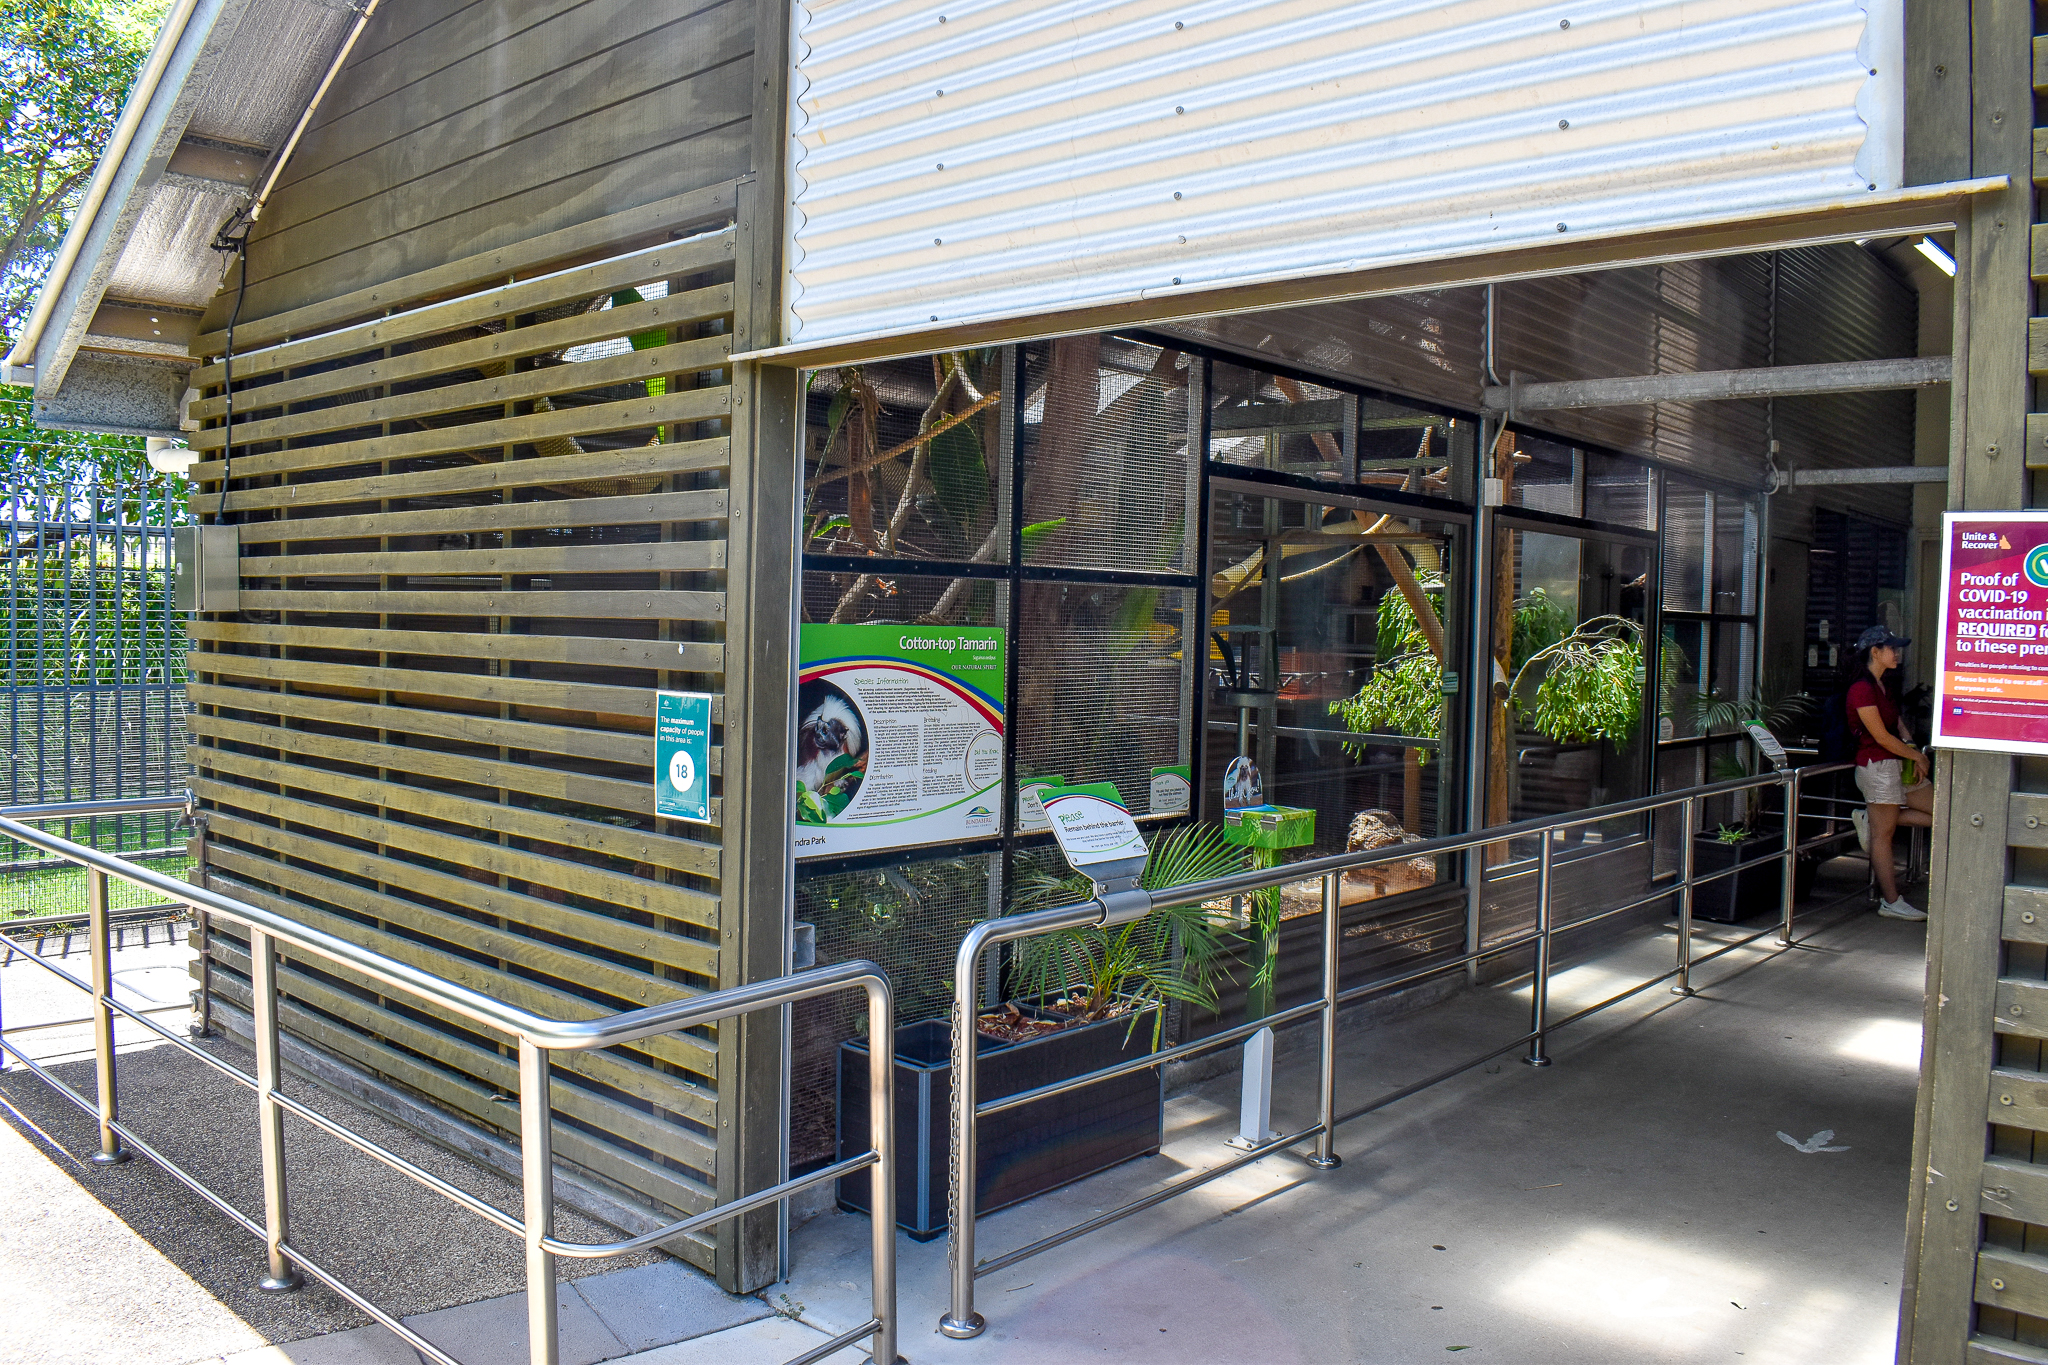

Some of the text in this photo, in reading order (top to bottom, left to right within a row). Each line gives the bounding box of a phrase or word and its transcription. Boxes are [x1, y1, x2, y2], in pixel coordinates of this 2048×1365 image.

[1962, 532, 1998, 540] Unite &
[1961, 541, 1999, 549] Recover
[1960, 572, 2020, 586] Proof of
[1959, 588, 2029, 604] COVID-19
[1958, 606, 2044, 620] vaccination
[1957, 622, 2037, 638] REQUIRED
[900, 636, 998, 654] Cotton-top Tamarin
[1956, 639, 1972, 652] to
[1974, 639, 2018, 654] these
[876, 677, 909, 685] Information
[660, 726, 681, 735] capacity
[676, 764, 688, 779] 18
[1058, 811, 1085, 825] Please
[811, 836, 826, 845] Park
